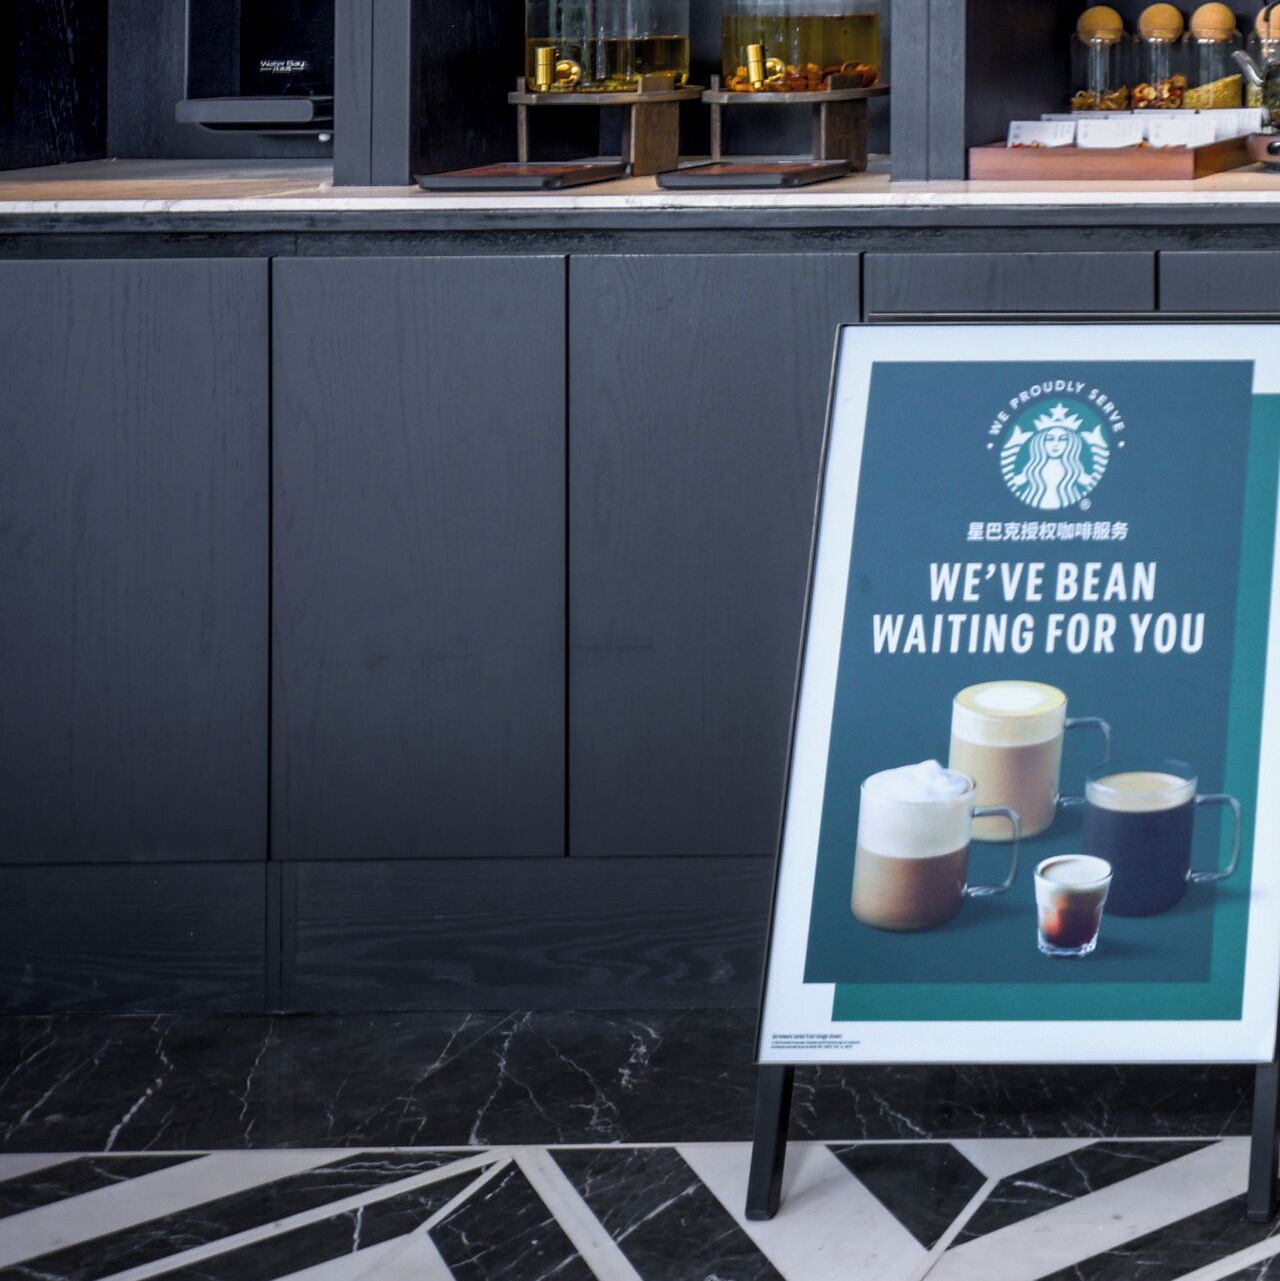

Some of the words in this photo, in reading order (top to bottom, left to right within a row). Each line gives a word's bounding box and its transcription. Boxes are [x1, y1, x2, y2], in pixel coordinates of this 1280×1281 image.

[988, 411, 1010, 435] WE
[1009, 380, 1086, 410] PROUDLY
[1088, 389, 1125, 433] SERVE
[967, 521, 1129, 542] 星巴克授权咖啡服务
[1055, 561, 1157, 602] BEAN
[873, 613, 1035, 654] WAITING
[1046, 613, 1117, 654] FOR
[1130, 612, 1205, 654] YOU
